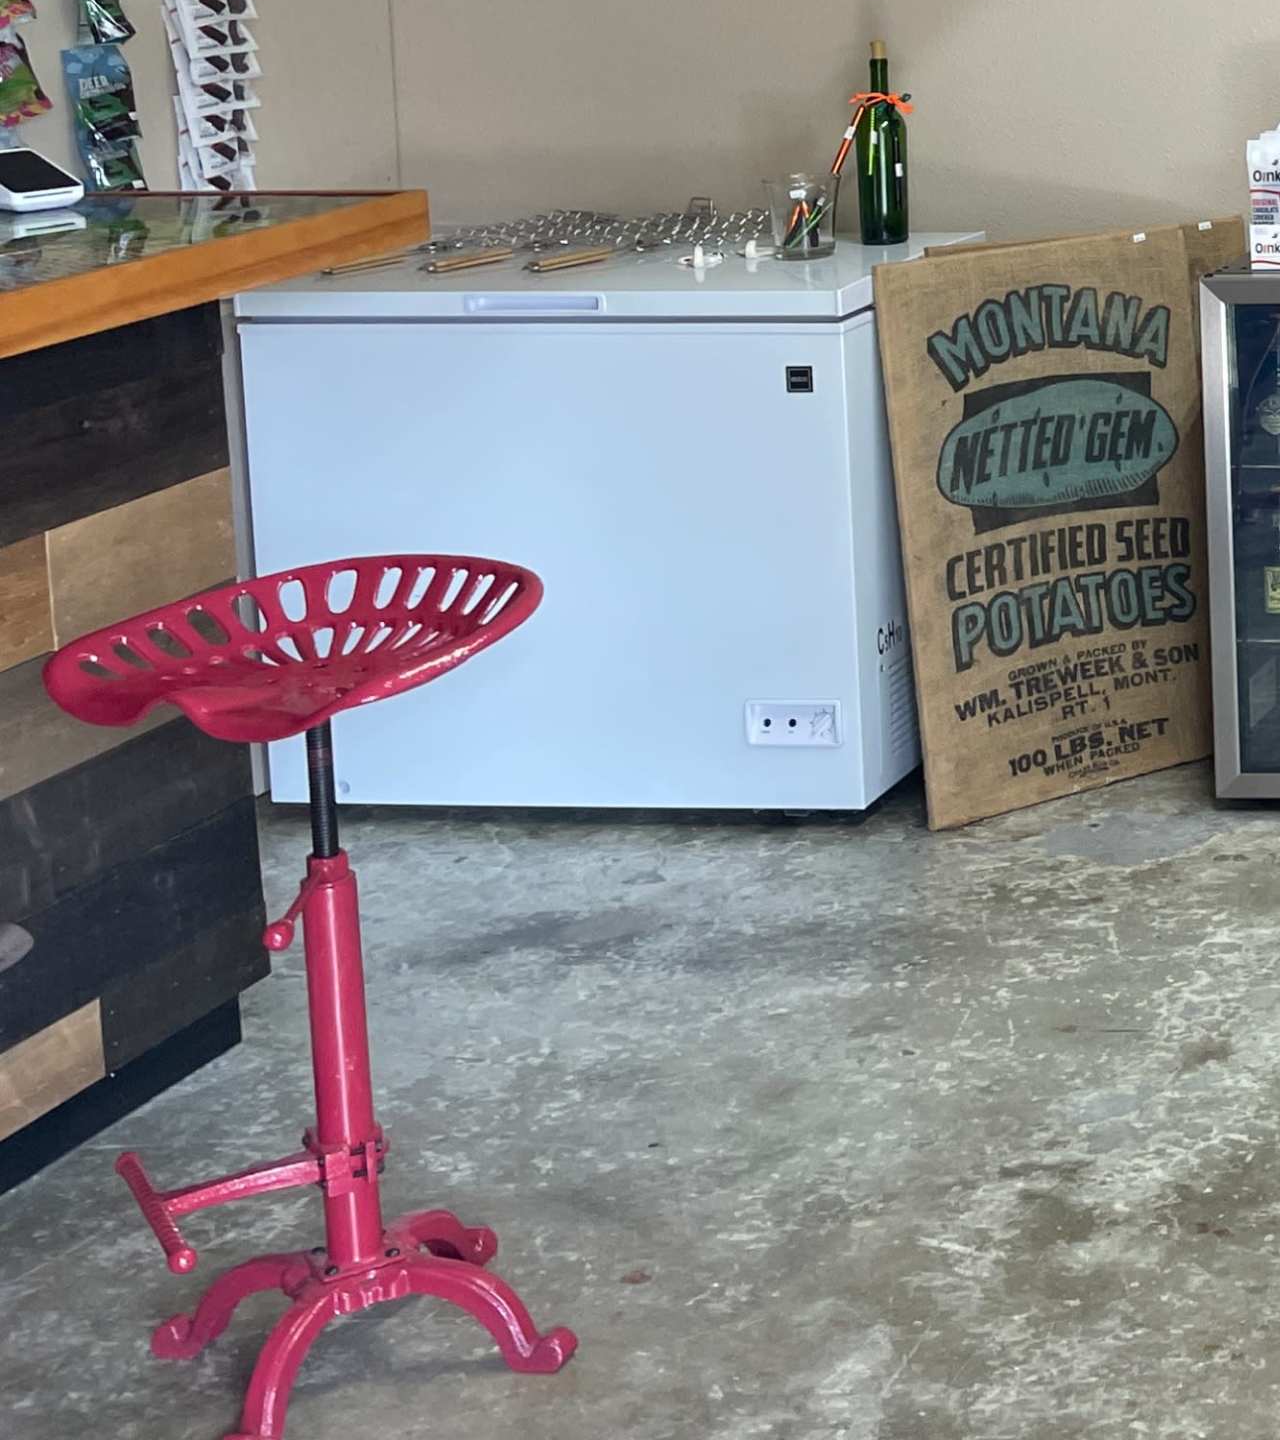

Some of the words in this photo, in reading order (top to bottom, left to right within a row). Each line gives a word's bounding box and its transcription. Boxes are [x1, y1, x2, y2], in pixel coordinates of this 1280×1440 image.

[927, 284, 1171, 392] MONTANA
[946, 524, 1107, 602] CERTIFIED
[1117, 516, 1190, 561] SEED
[951, 563, 1197, 673] POTATOES
[955, 689, 1007, 722] WM.
[1009, 656, 1126, 700] TREWEEK
[1132, 653, 1149, 670] &
[1153, 643, 1199, 667] SON
[1008, 658, 1058, 682] GROWN
[1077, 643, 1126, 661] PACKED
[1132, 640, 1148, 651] BY
[987, 682, 1108, 728] KALISPELL,
[1113, 668, 1177, 691] MONT.
[1062, 700, 1096, 720] RT.
[1103, 695, 1111, 711] 1
[1008, 749, 1048, 777] 100
[1055, 730, 1112, 761] LBS.
[1119, 718, 1169, 744] NET
[1043, 756, 1083, 777] WHEN
[1090, 742, 1140, 761] PACKED
